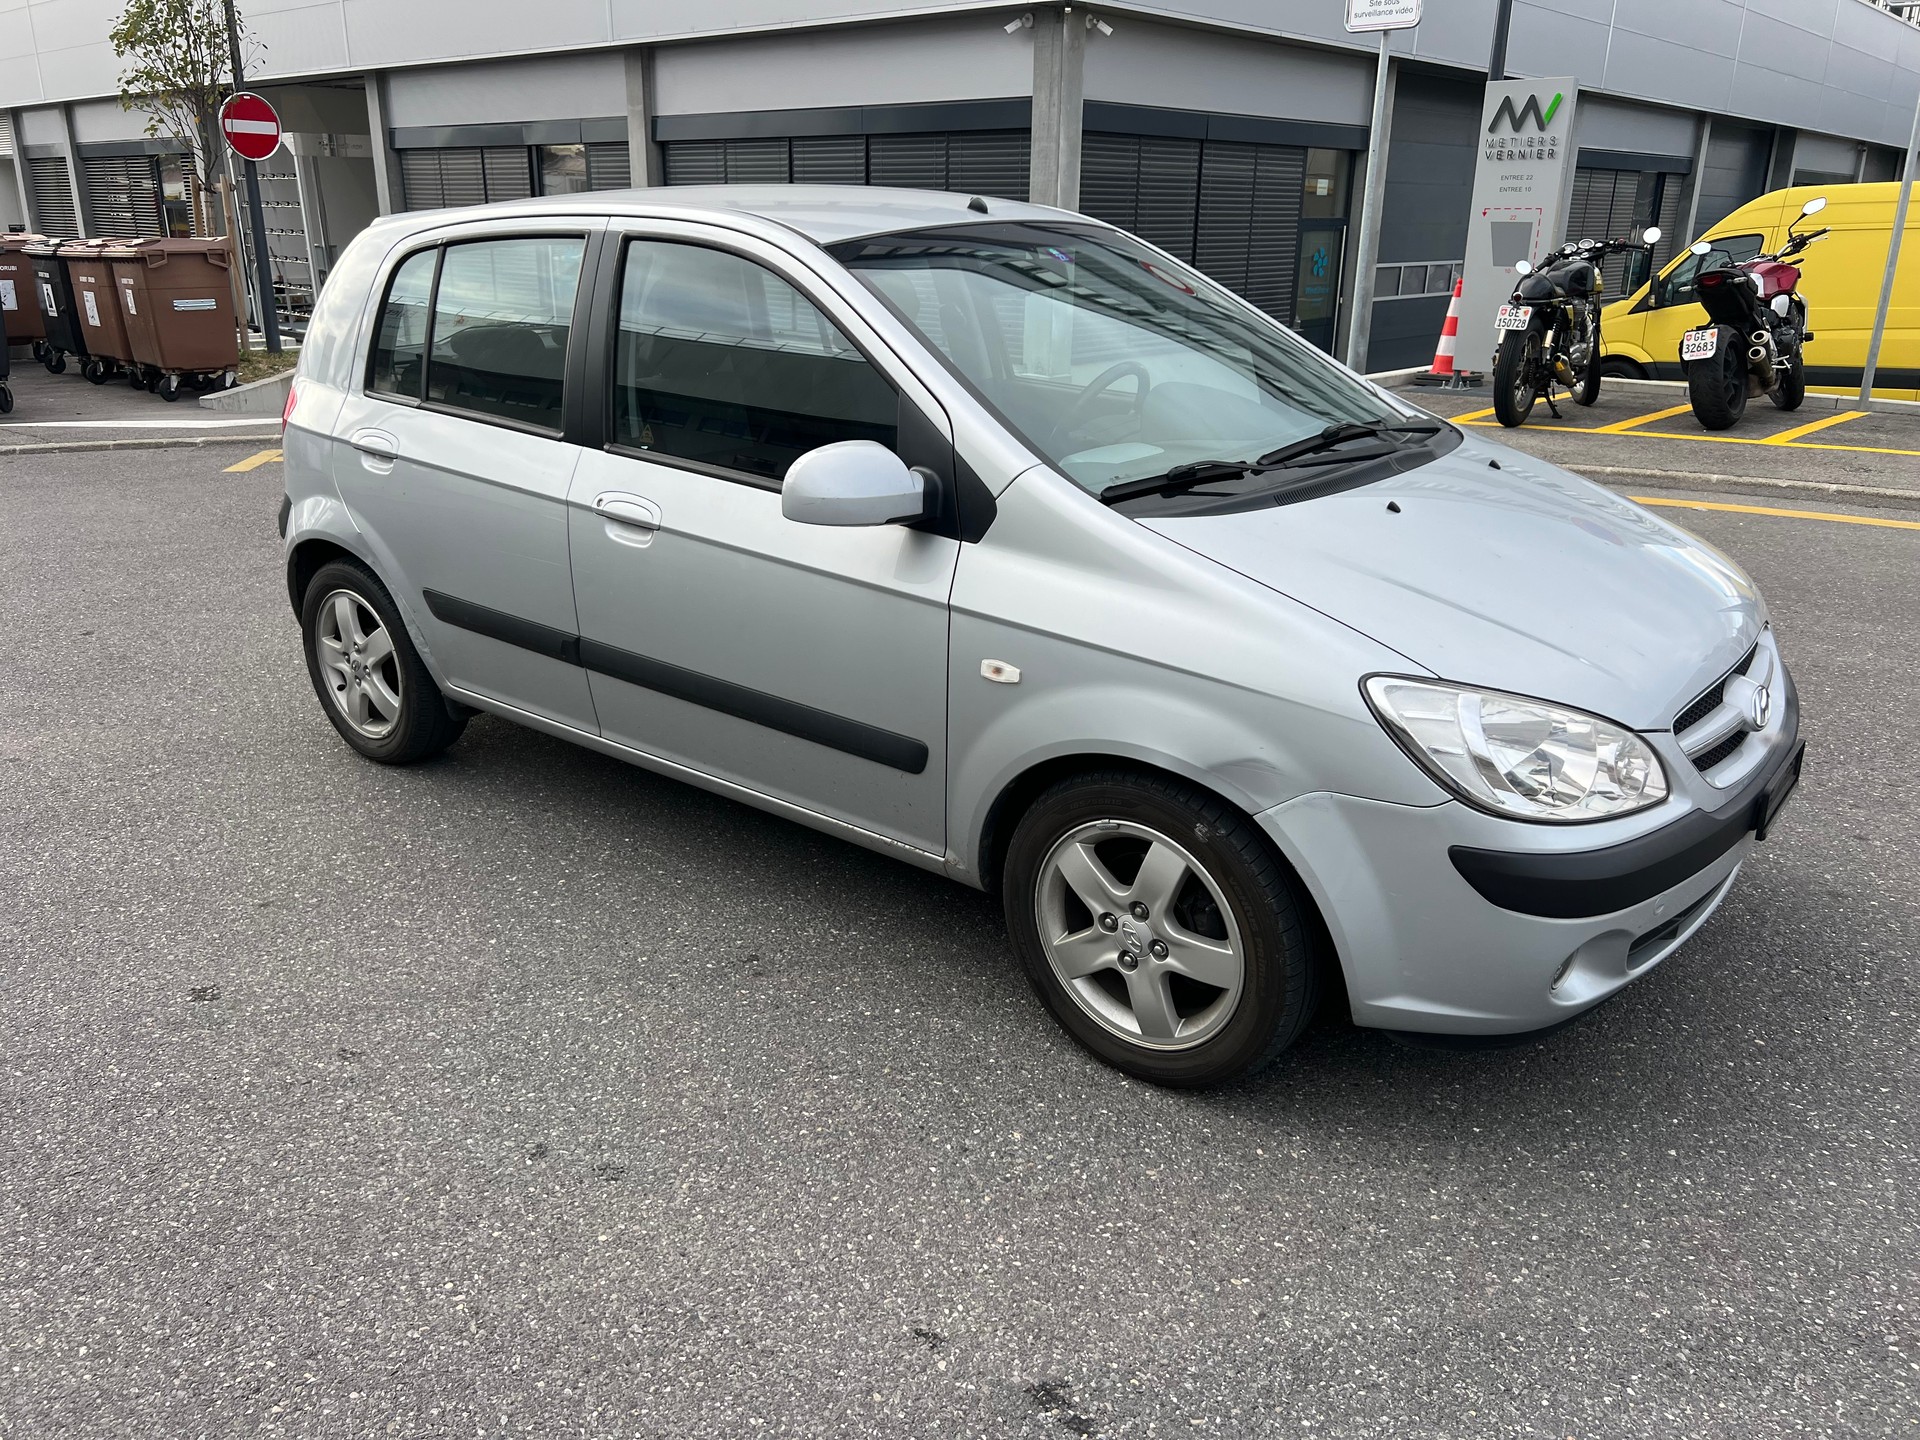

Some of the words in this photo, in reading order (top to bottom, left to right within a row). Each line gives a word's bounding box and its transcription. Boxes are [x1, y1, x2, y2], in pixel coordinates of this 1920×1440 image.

[1354, 9, 1394, 18] surveillance
[1485, 136, 1558, 148] METIERS
[1485, 148, 1556, 160] VERNIER
[1508, 308, 1520, 317] GE
[1497, 318, 1526, 328] 150728
[1694, 331, 1706, 341] GE
[1684, 341, 1714, 353] 32683
